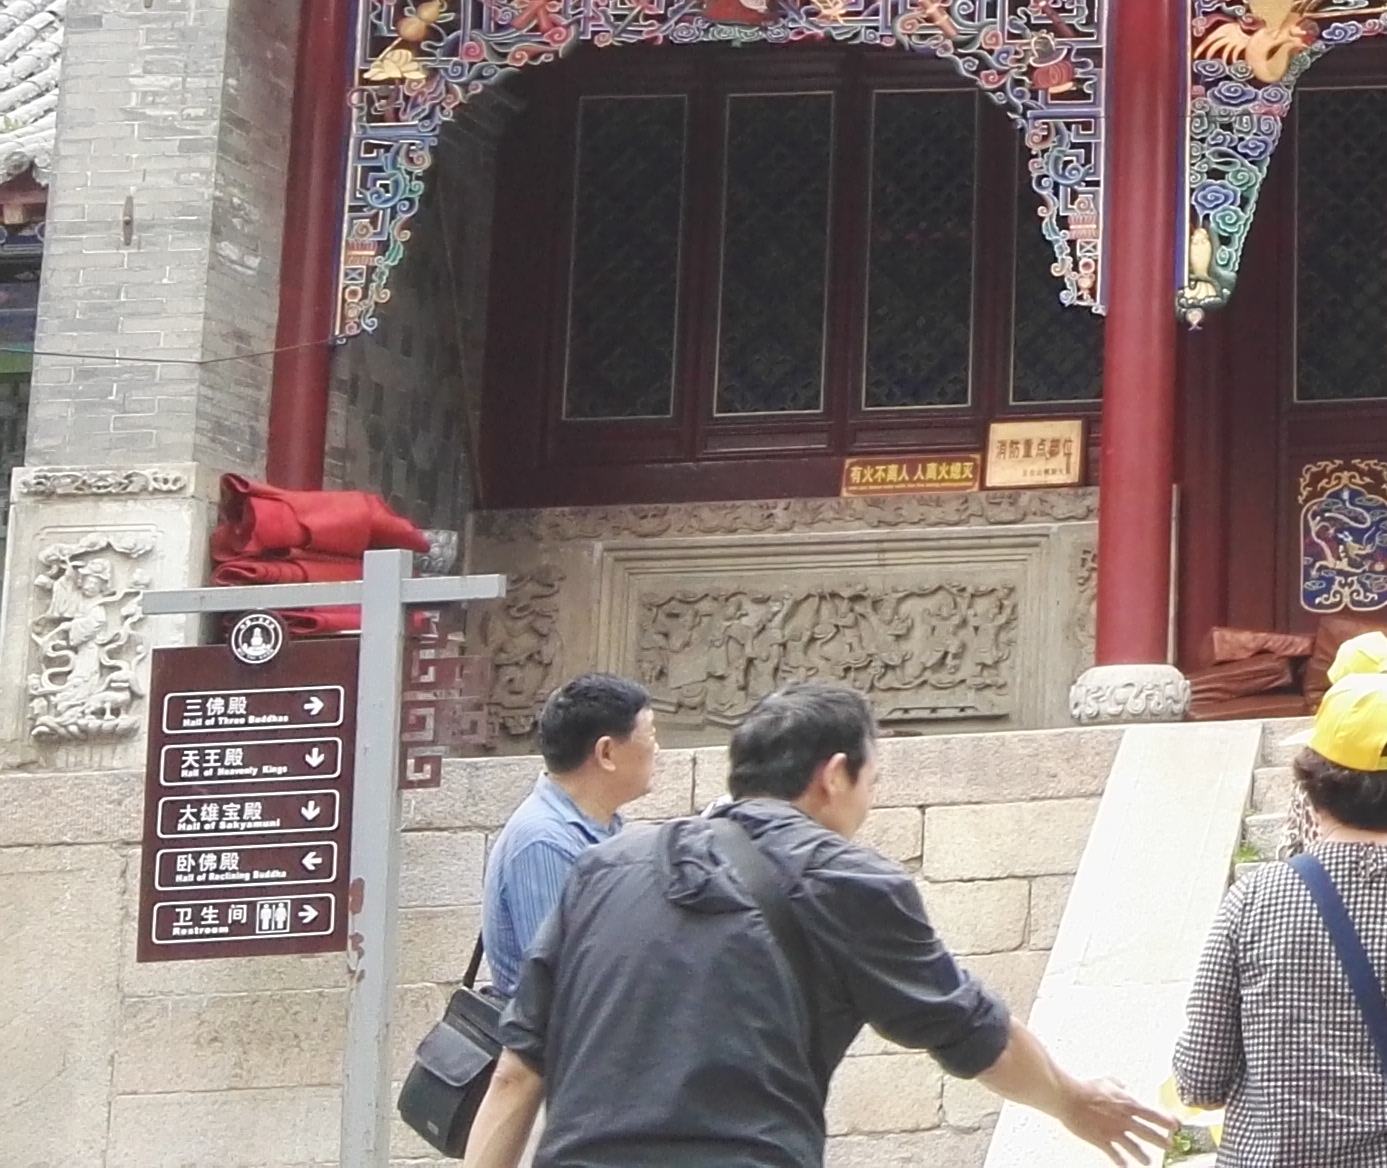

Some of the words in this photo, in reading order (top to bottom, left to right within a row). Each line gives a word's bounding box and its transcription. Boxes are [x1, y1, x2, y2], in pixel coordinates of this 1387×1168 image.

[995, 437, 1073, 460] 消防重点部位
[183, 696, 247, 716] 三佛殿
[182, 717, 203, 727] Hall
[204, 716, 215, 726] of
[218, 716, 245, 725] Three
[248, 714, 289, 724] Buddhas
[181, 748, 244, 769] 天王殿
[181, 768, 199, 778] Hall
[203, 768, 213, 777] of
[217, 766, 258, 776] Heavenly
[262, 765, 288, 775] Kings
[178, 801, 262, 822] 大雄宝殿
[177, 821, 201, 831] Hall
[203, 821, 216, 830] of
[219, 818, 281, 830] Sakyamuni
[176, 852, 239, 872] 卧佛殿
[175, 873, 194, 882] Hall
[196, 873, 206, 882] of
[208, 871, 250, 881] Reclining
[253, 870, 287, 879] Buddha
[172, 904, 248, 926] 卫生间
[172, 926, 229, 936] Restroom
